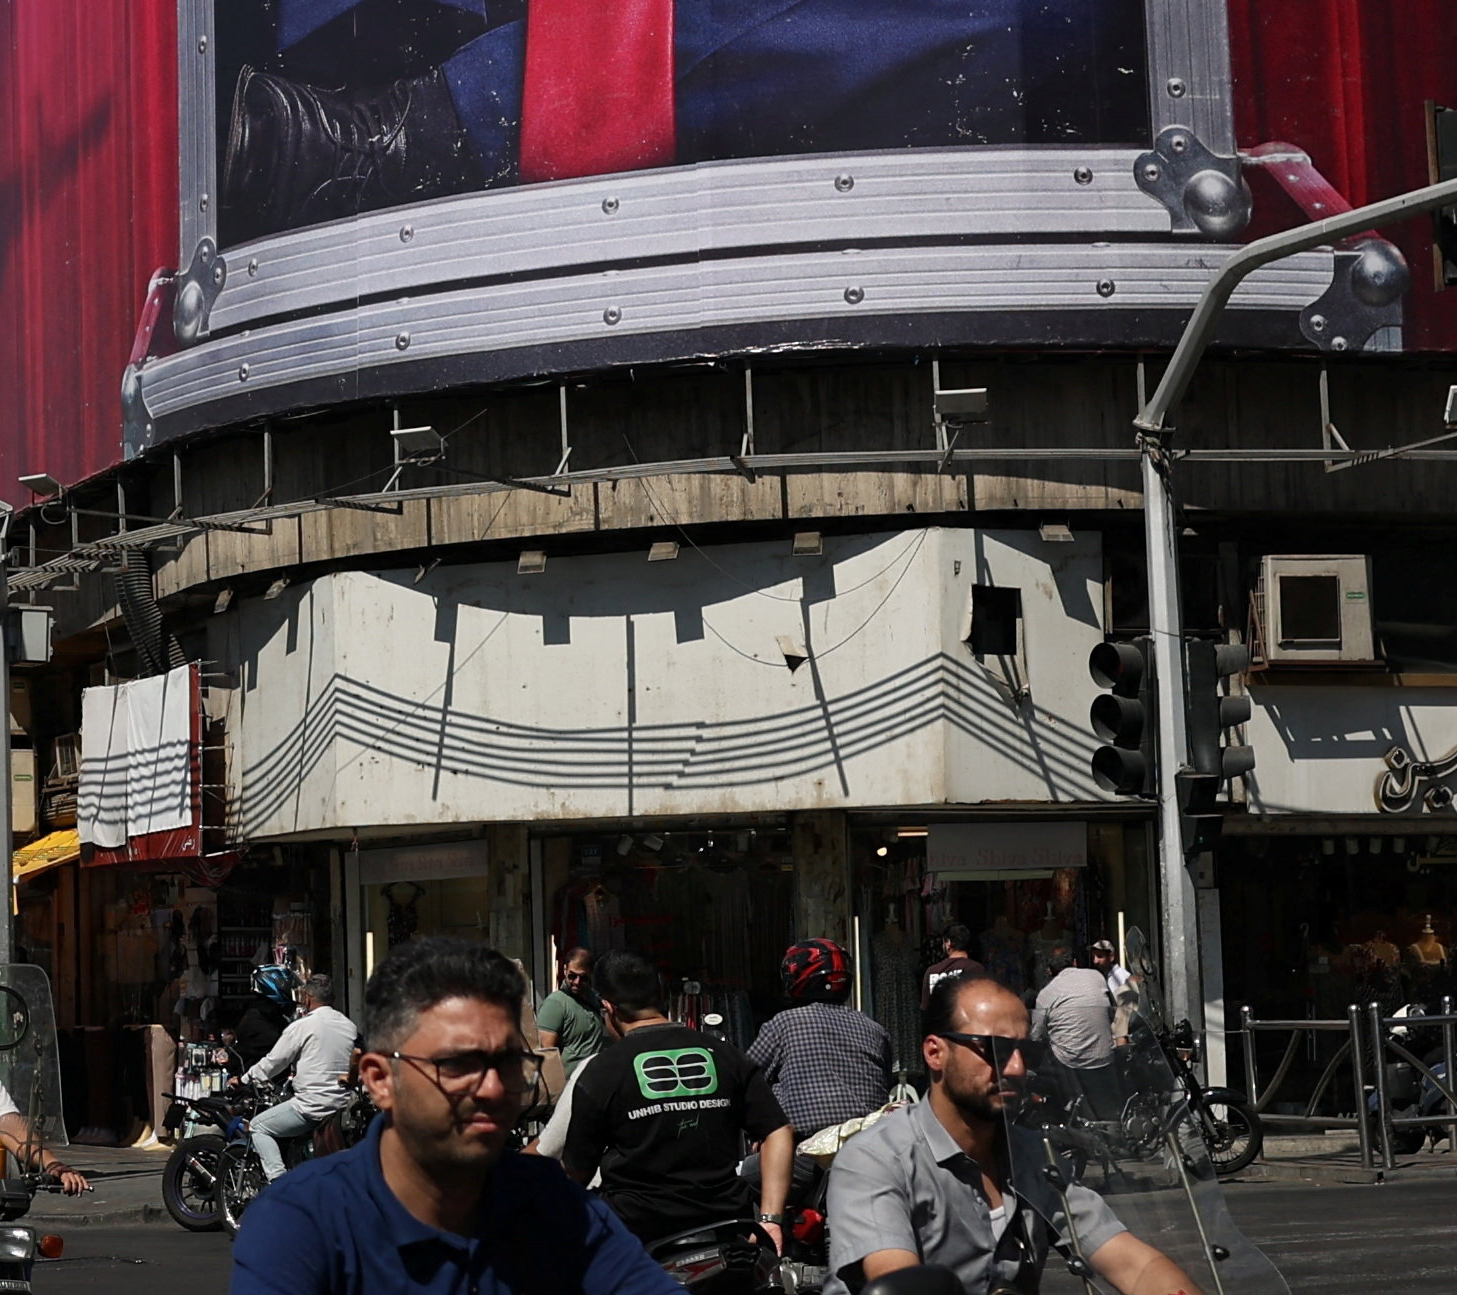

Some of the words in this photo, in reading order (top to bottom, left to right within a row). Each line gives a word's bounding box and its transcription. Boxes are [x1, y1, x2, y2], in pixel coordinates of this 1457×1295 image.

[627, 1103, 663, 1120] UNHIB
[663, 1099, 699, 1112] STUDIO
[699, 1097, 732, 1108] DESIGN
